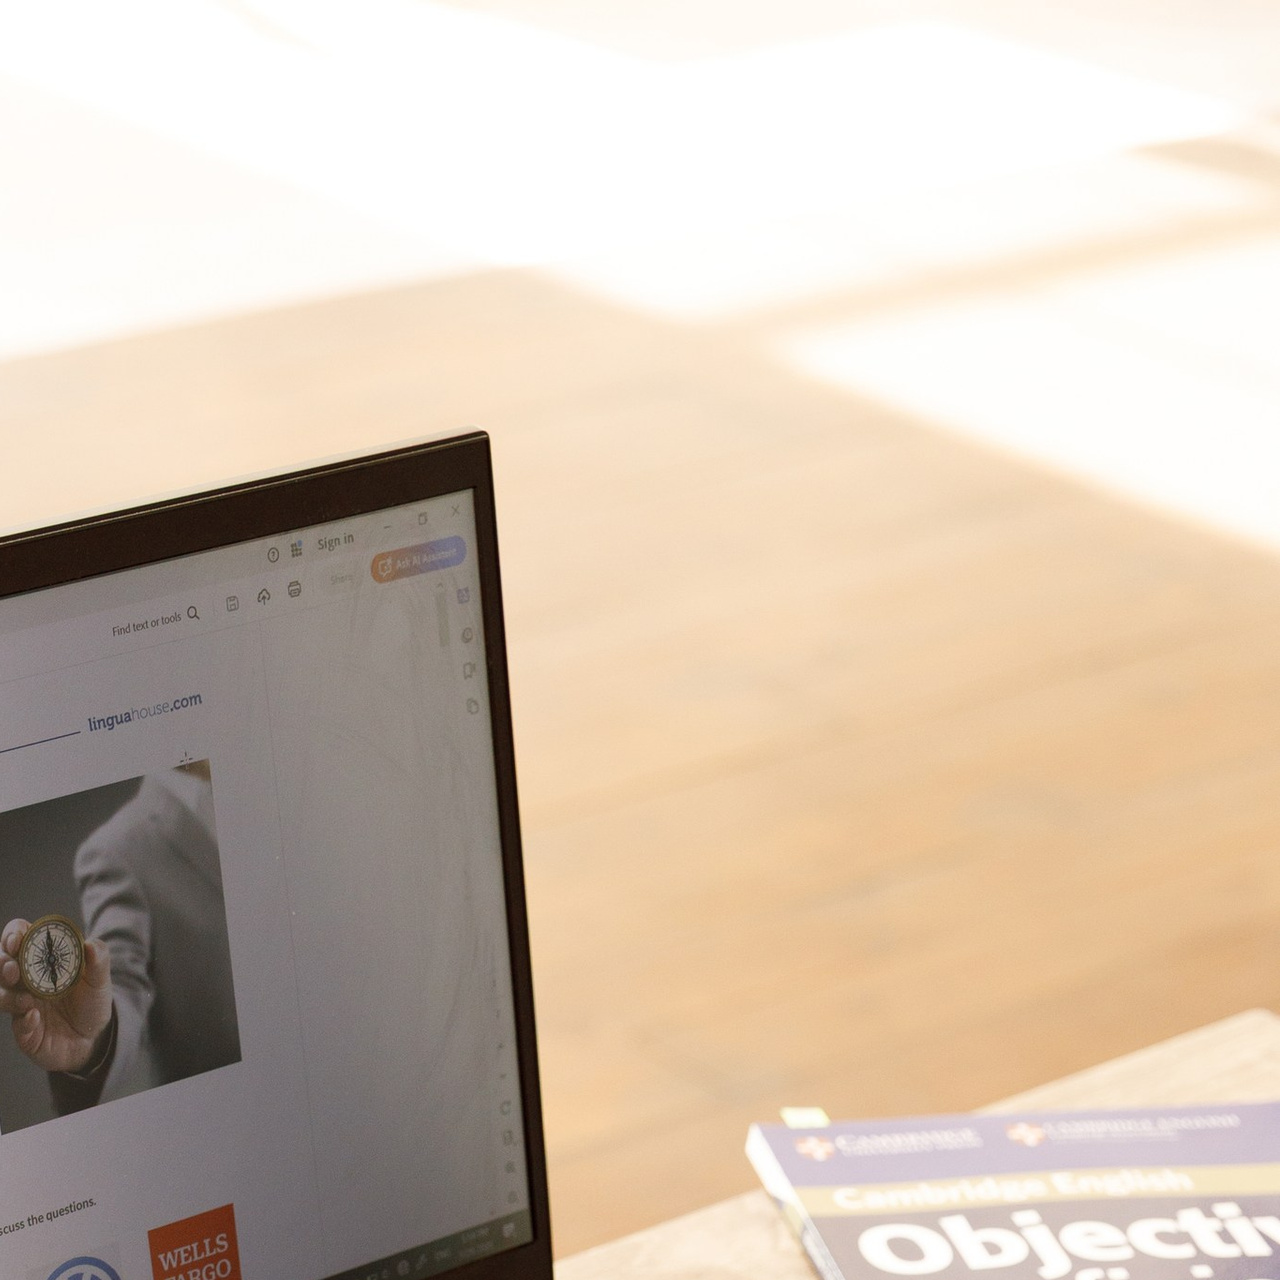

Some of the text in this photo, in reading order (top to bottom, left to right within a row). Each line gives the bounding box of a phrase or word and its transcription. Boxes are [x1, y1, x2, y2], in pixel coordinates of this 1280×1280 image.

[318, 532, 354, 551] Sign in
[112, 612, 182, 636] Find text or tools
[88, 694, 202, 732] linguahouse.com
[833, 1168, 1194, 1210] Cambridge English
[27, 1214, 44, 1227] the
[46, 1197, 97, 1222] questions.
[158, 1233, 228, 1271] WELLS
